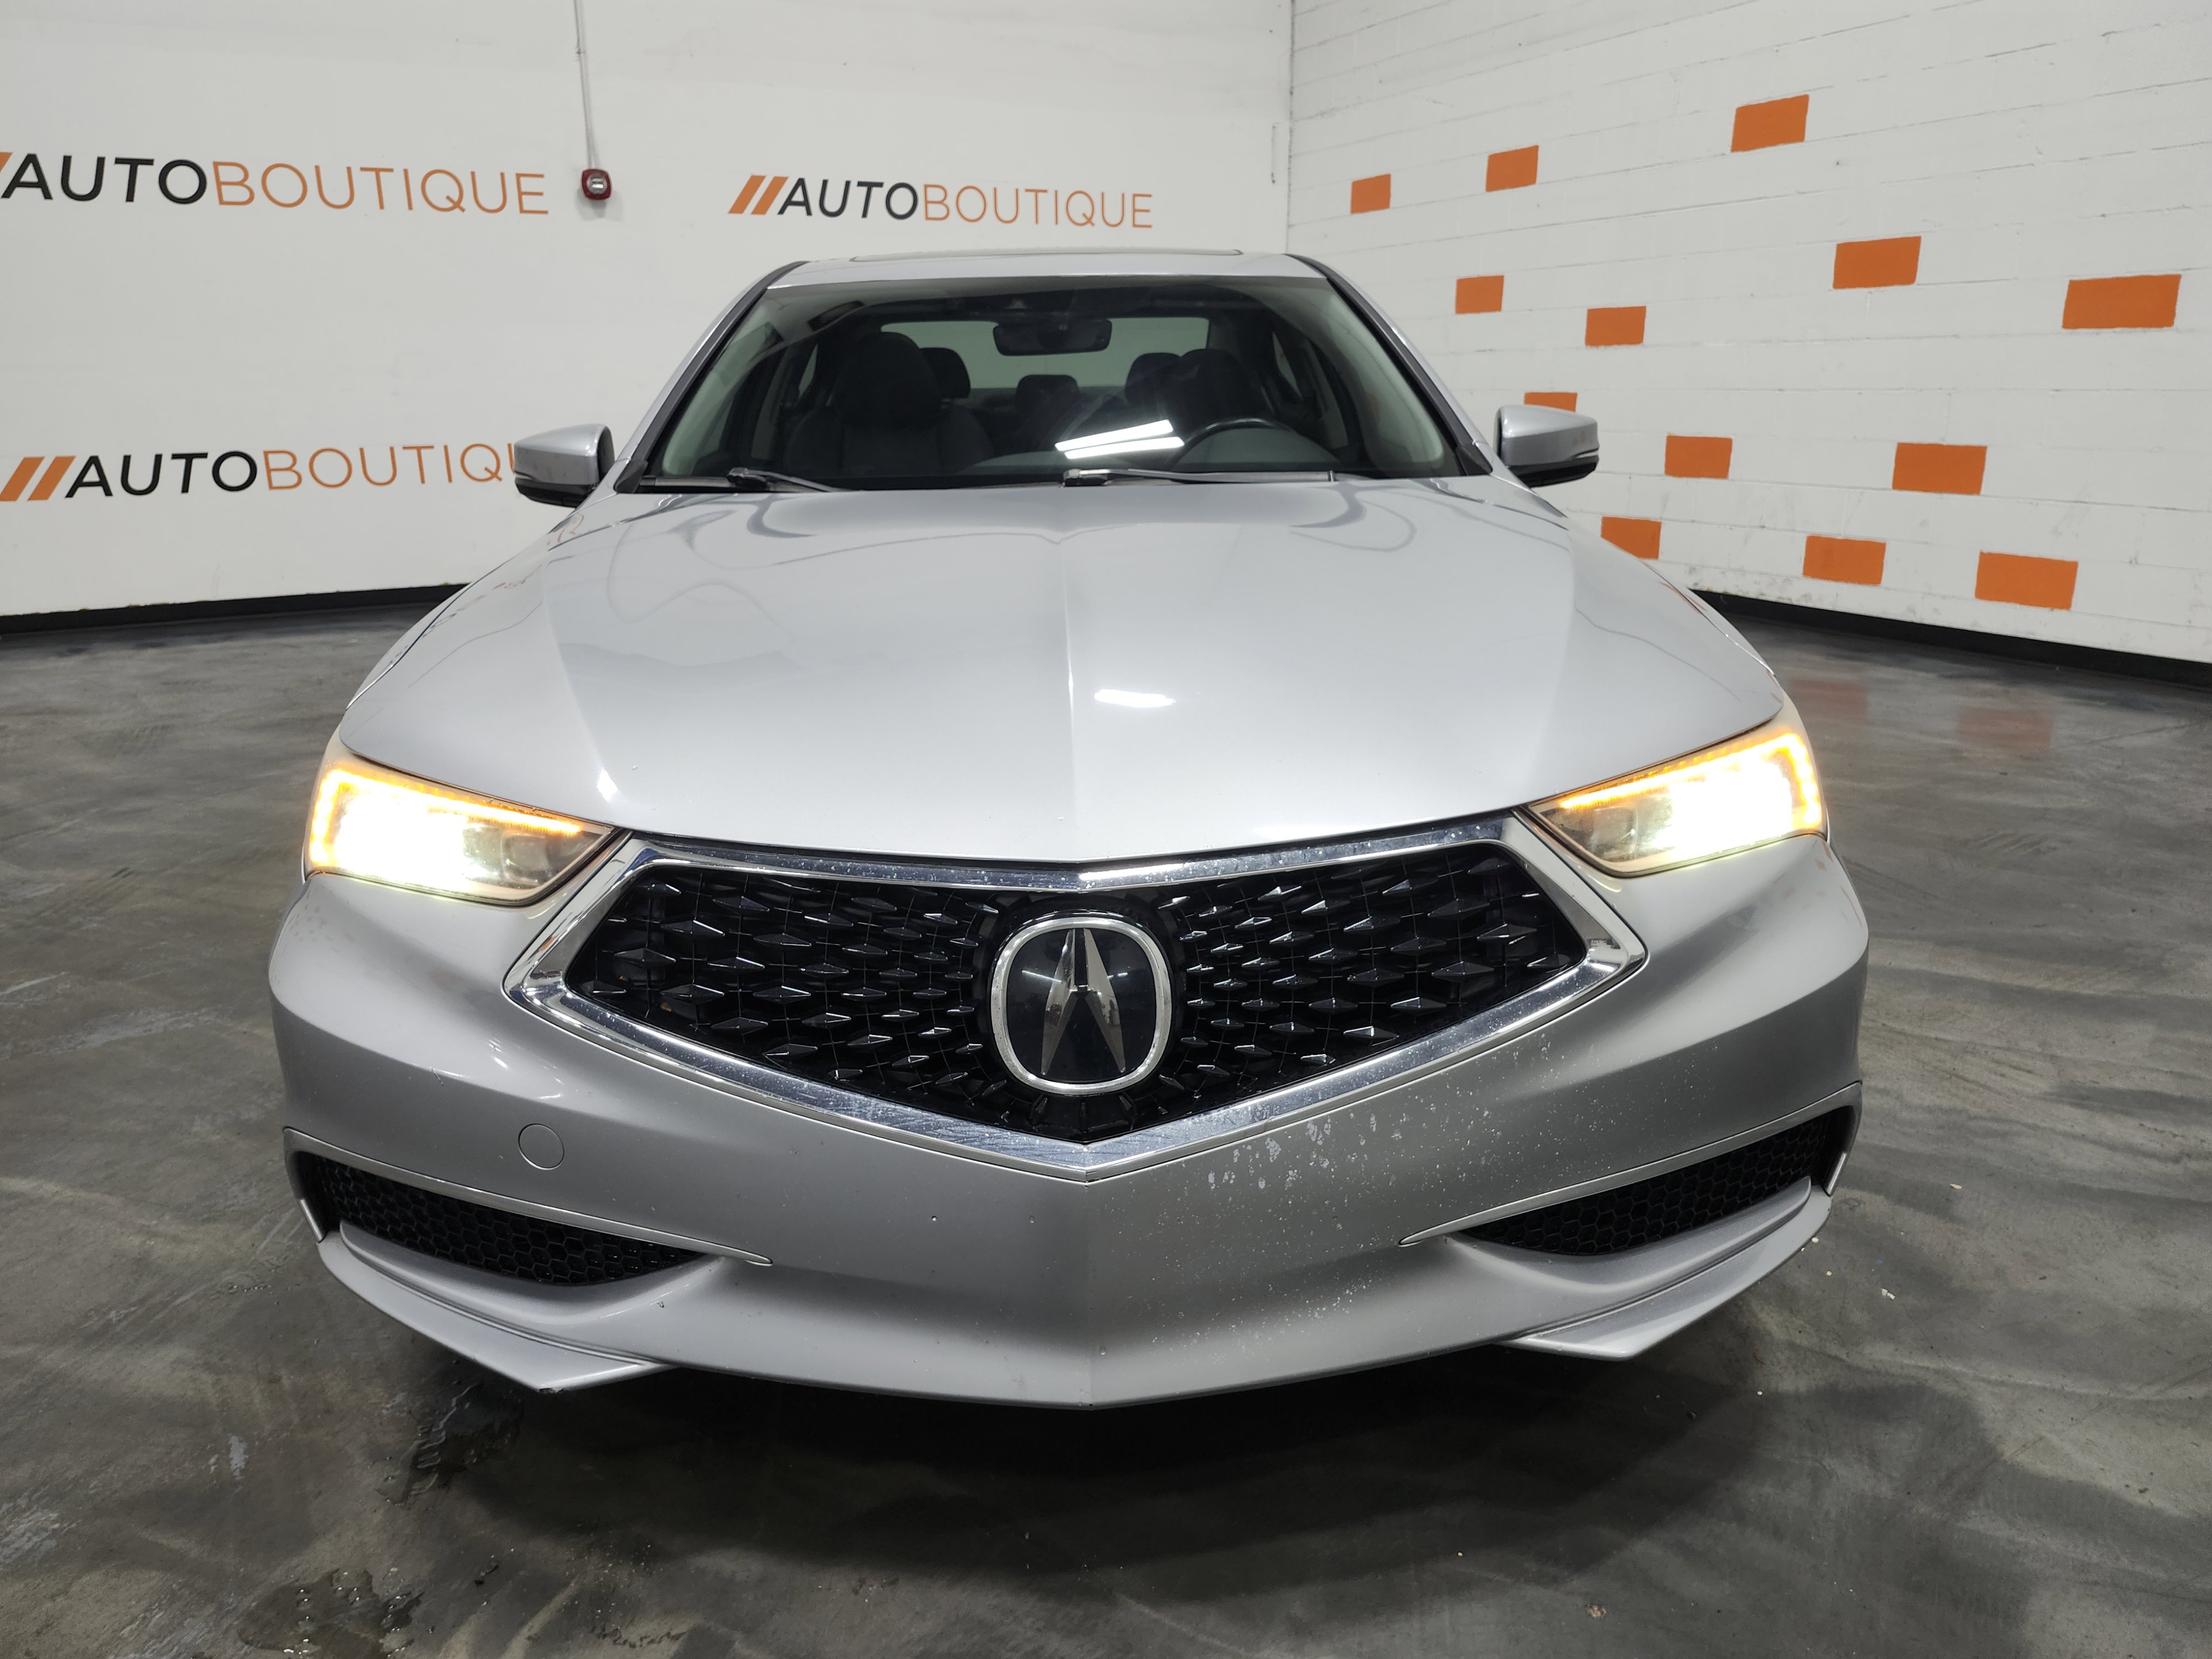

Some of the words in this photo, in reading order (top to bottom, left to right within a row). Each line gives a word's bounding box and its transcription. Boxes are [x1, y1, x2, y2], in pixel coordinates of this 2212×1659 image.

[1, 152, 549, 215] AUTOBOUTIQUE
[777, 177, 1152, 228] AUTOBOUTIQUE
[65, 443, 514, 499] AUTOBOUTIQ
